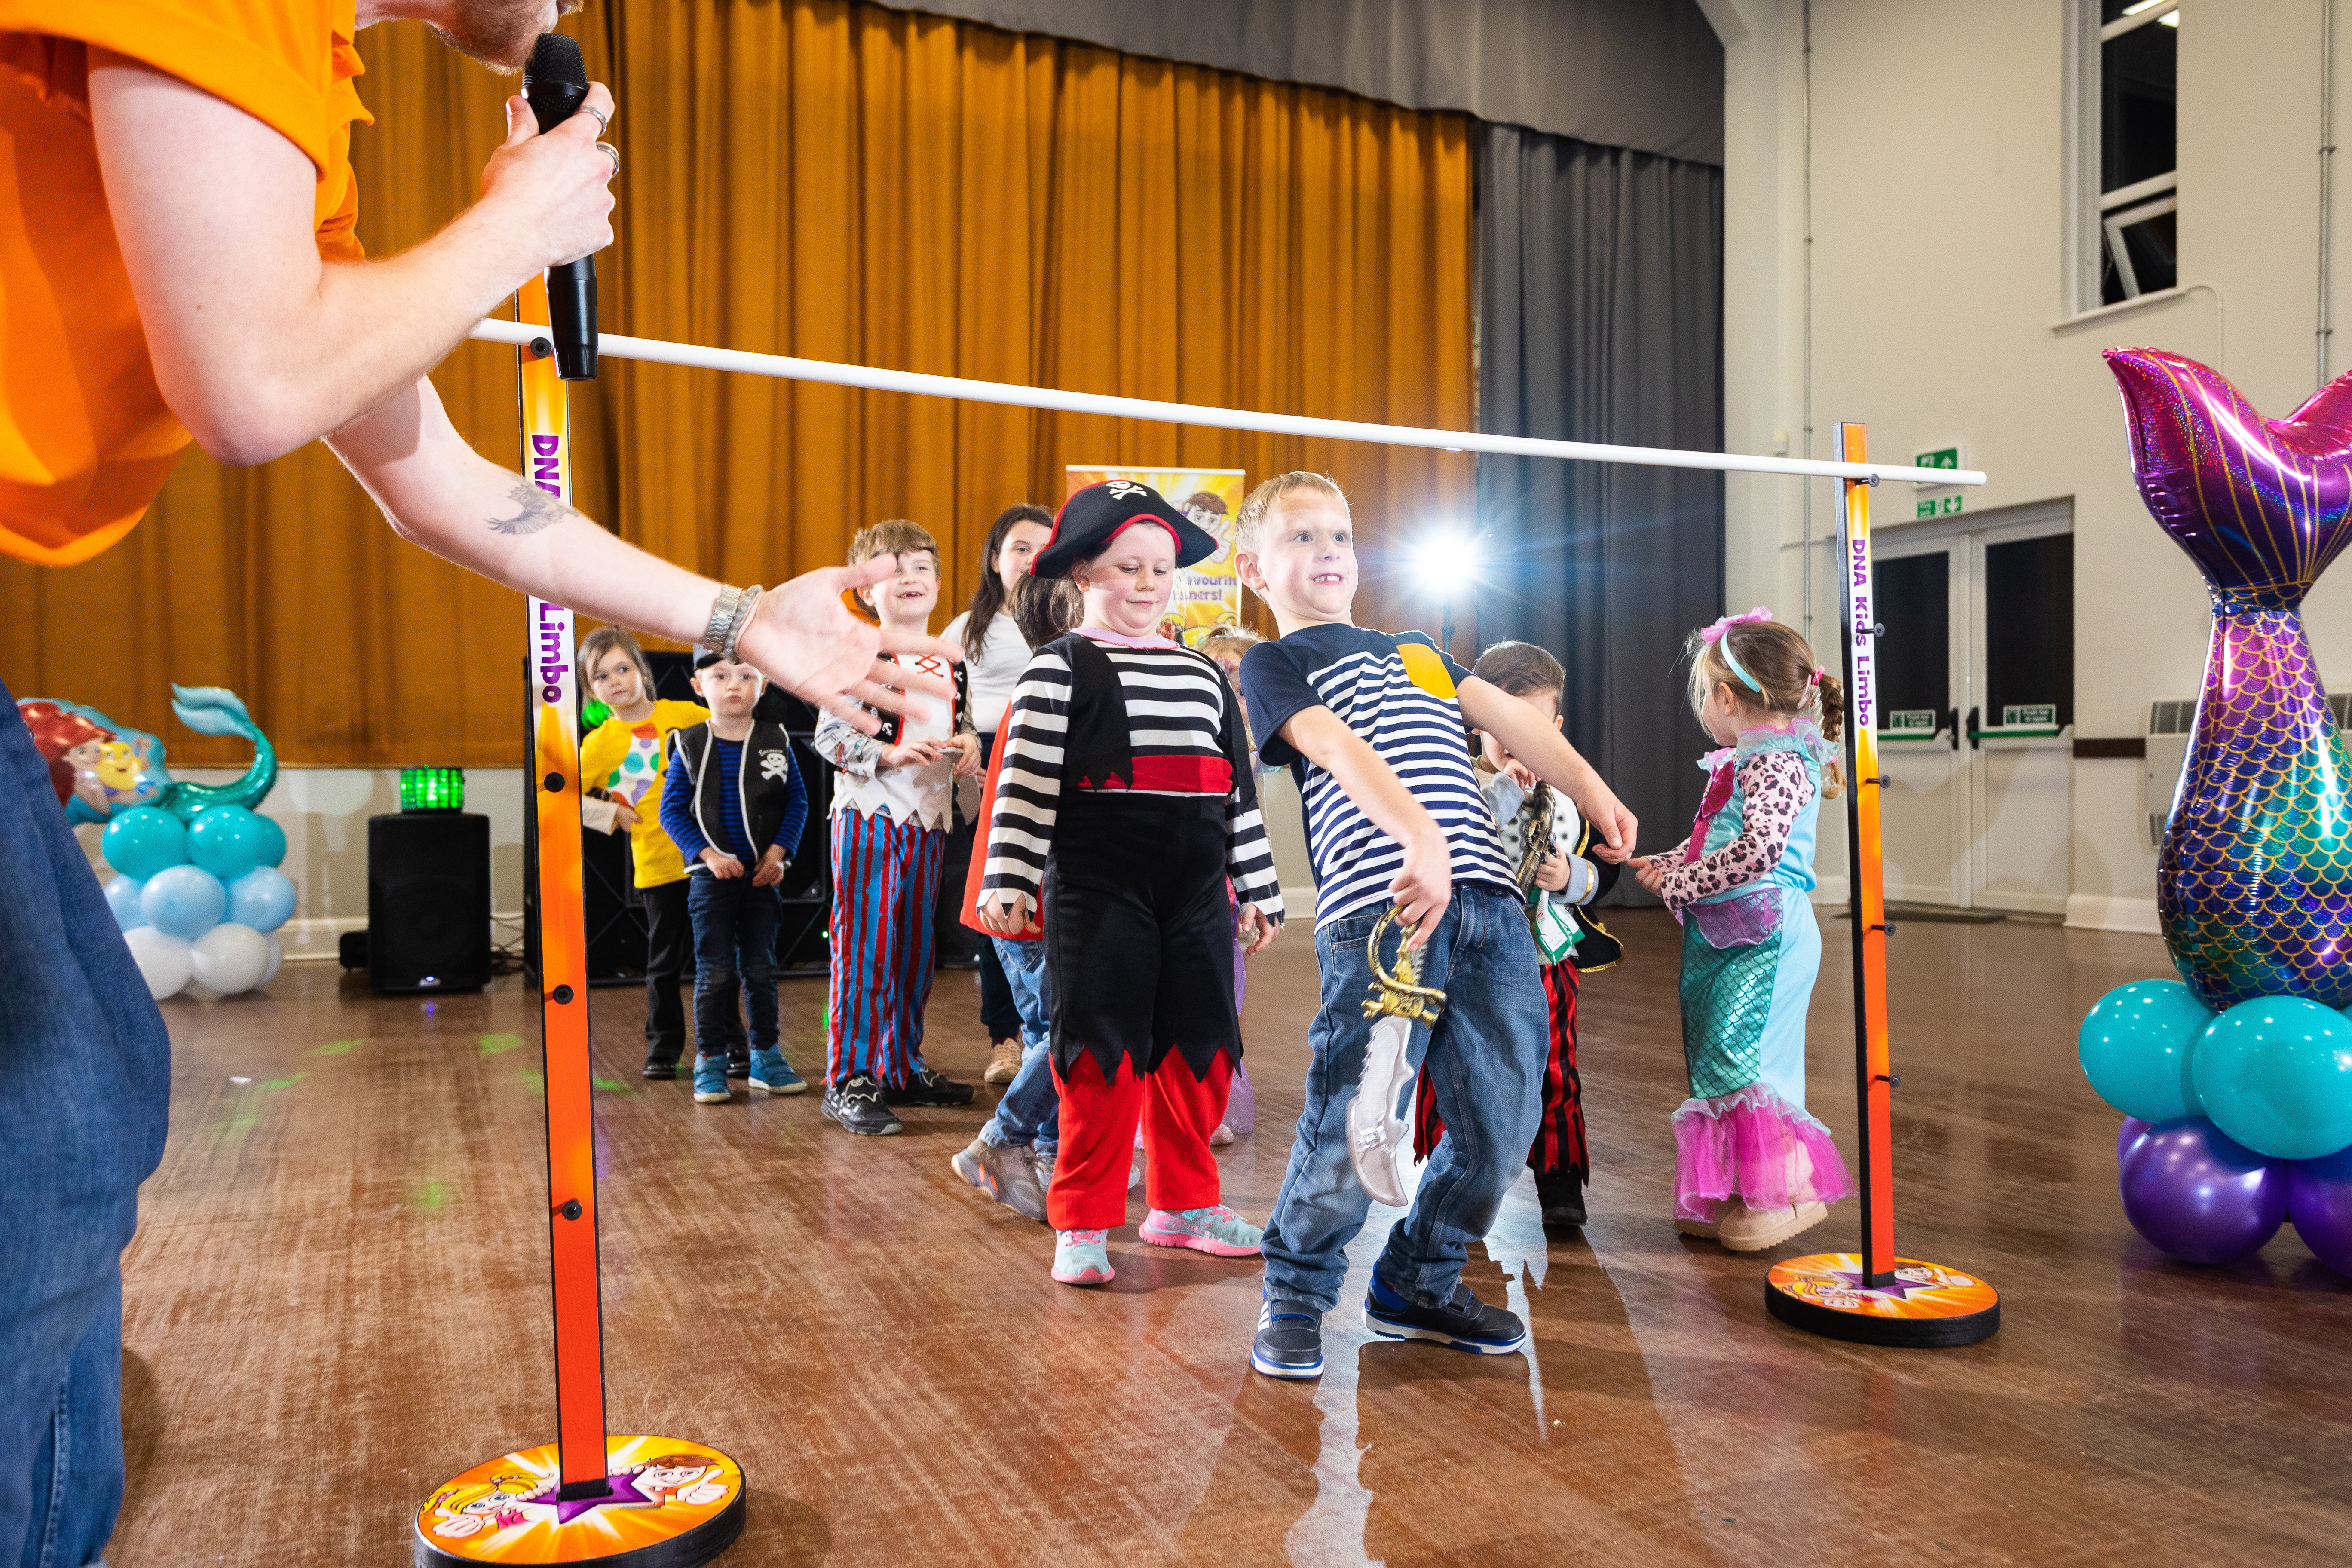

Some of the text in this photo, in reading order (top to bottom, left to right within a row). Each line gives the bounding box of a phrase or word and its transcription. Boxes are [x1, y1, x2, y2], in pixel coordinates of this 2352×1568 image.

[1185, 575, 1237, 586] avourite
[539, 603, 568, 703] Limbo
[1852, 539, 1872, 726] DNA Kids Limbo
